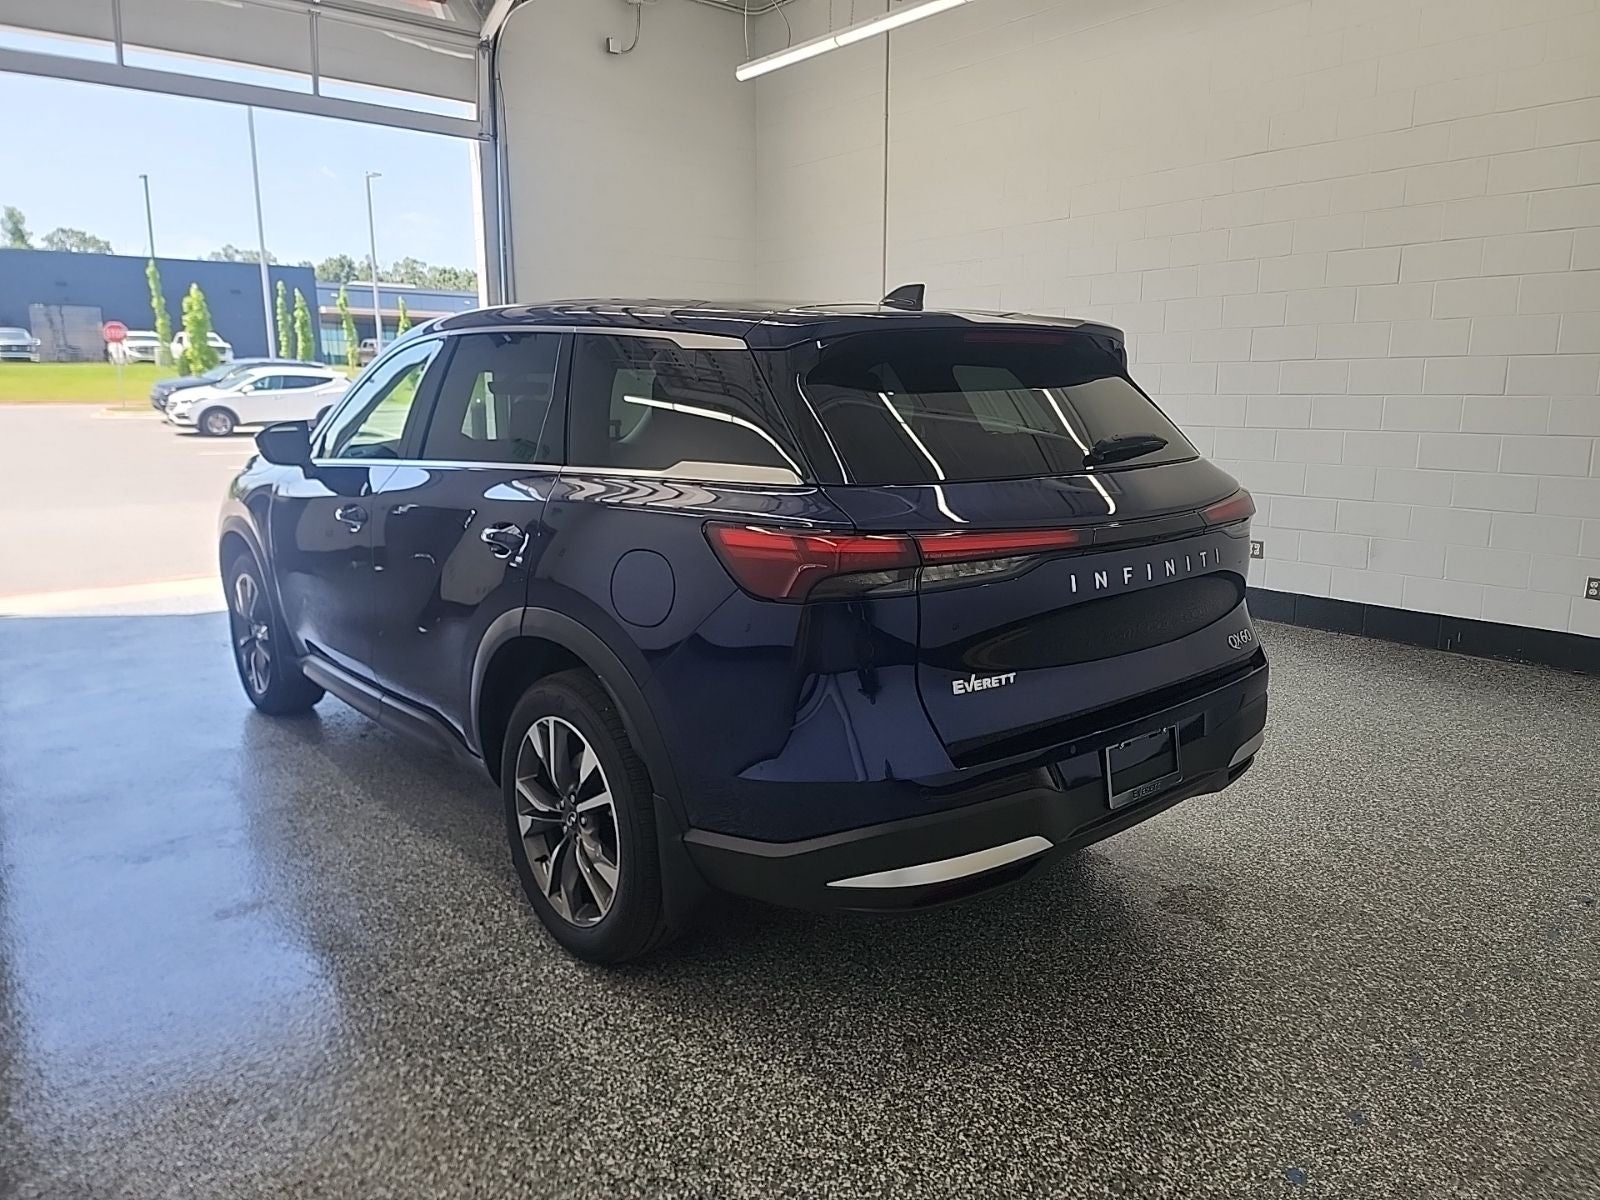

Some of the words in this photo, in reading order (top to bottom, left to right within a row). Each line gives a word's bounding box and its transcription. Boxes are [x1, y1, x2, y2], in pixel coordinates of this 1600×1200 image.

[1070, 548, 1220, 593] INFINITI
[1228, 628, 1252, 650] QX60
[952, 672, 1017, 695] EVERETT
